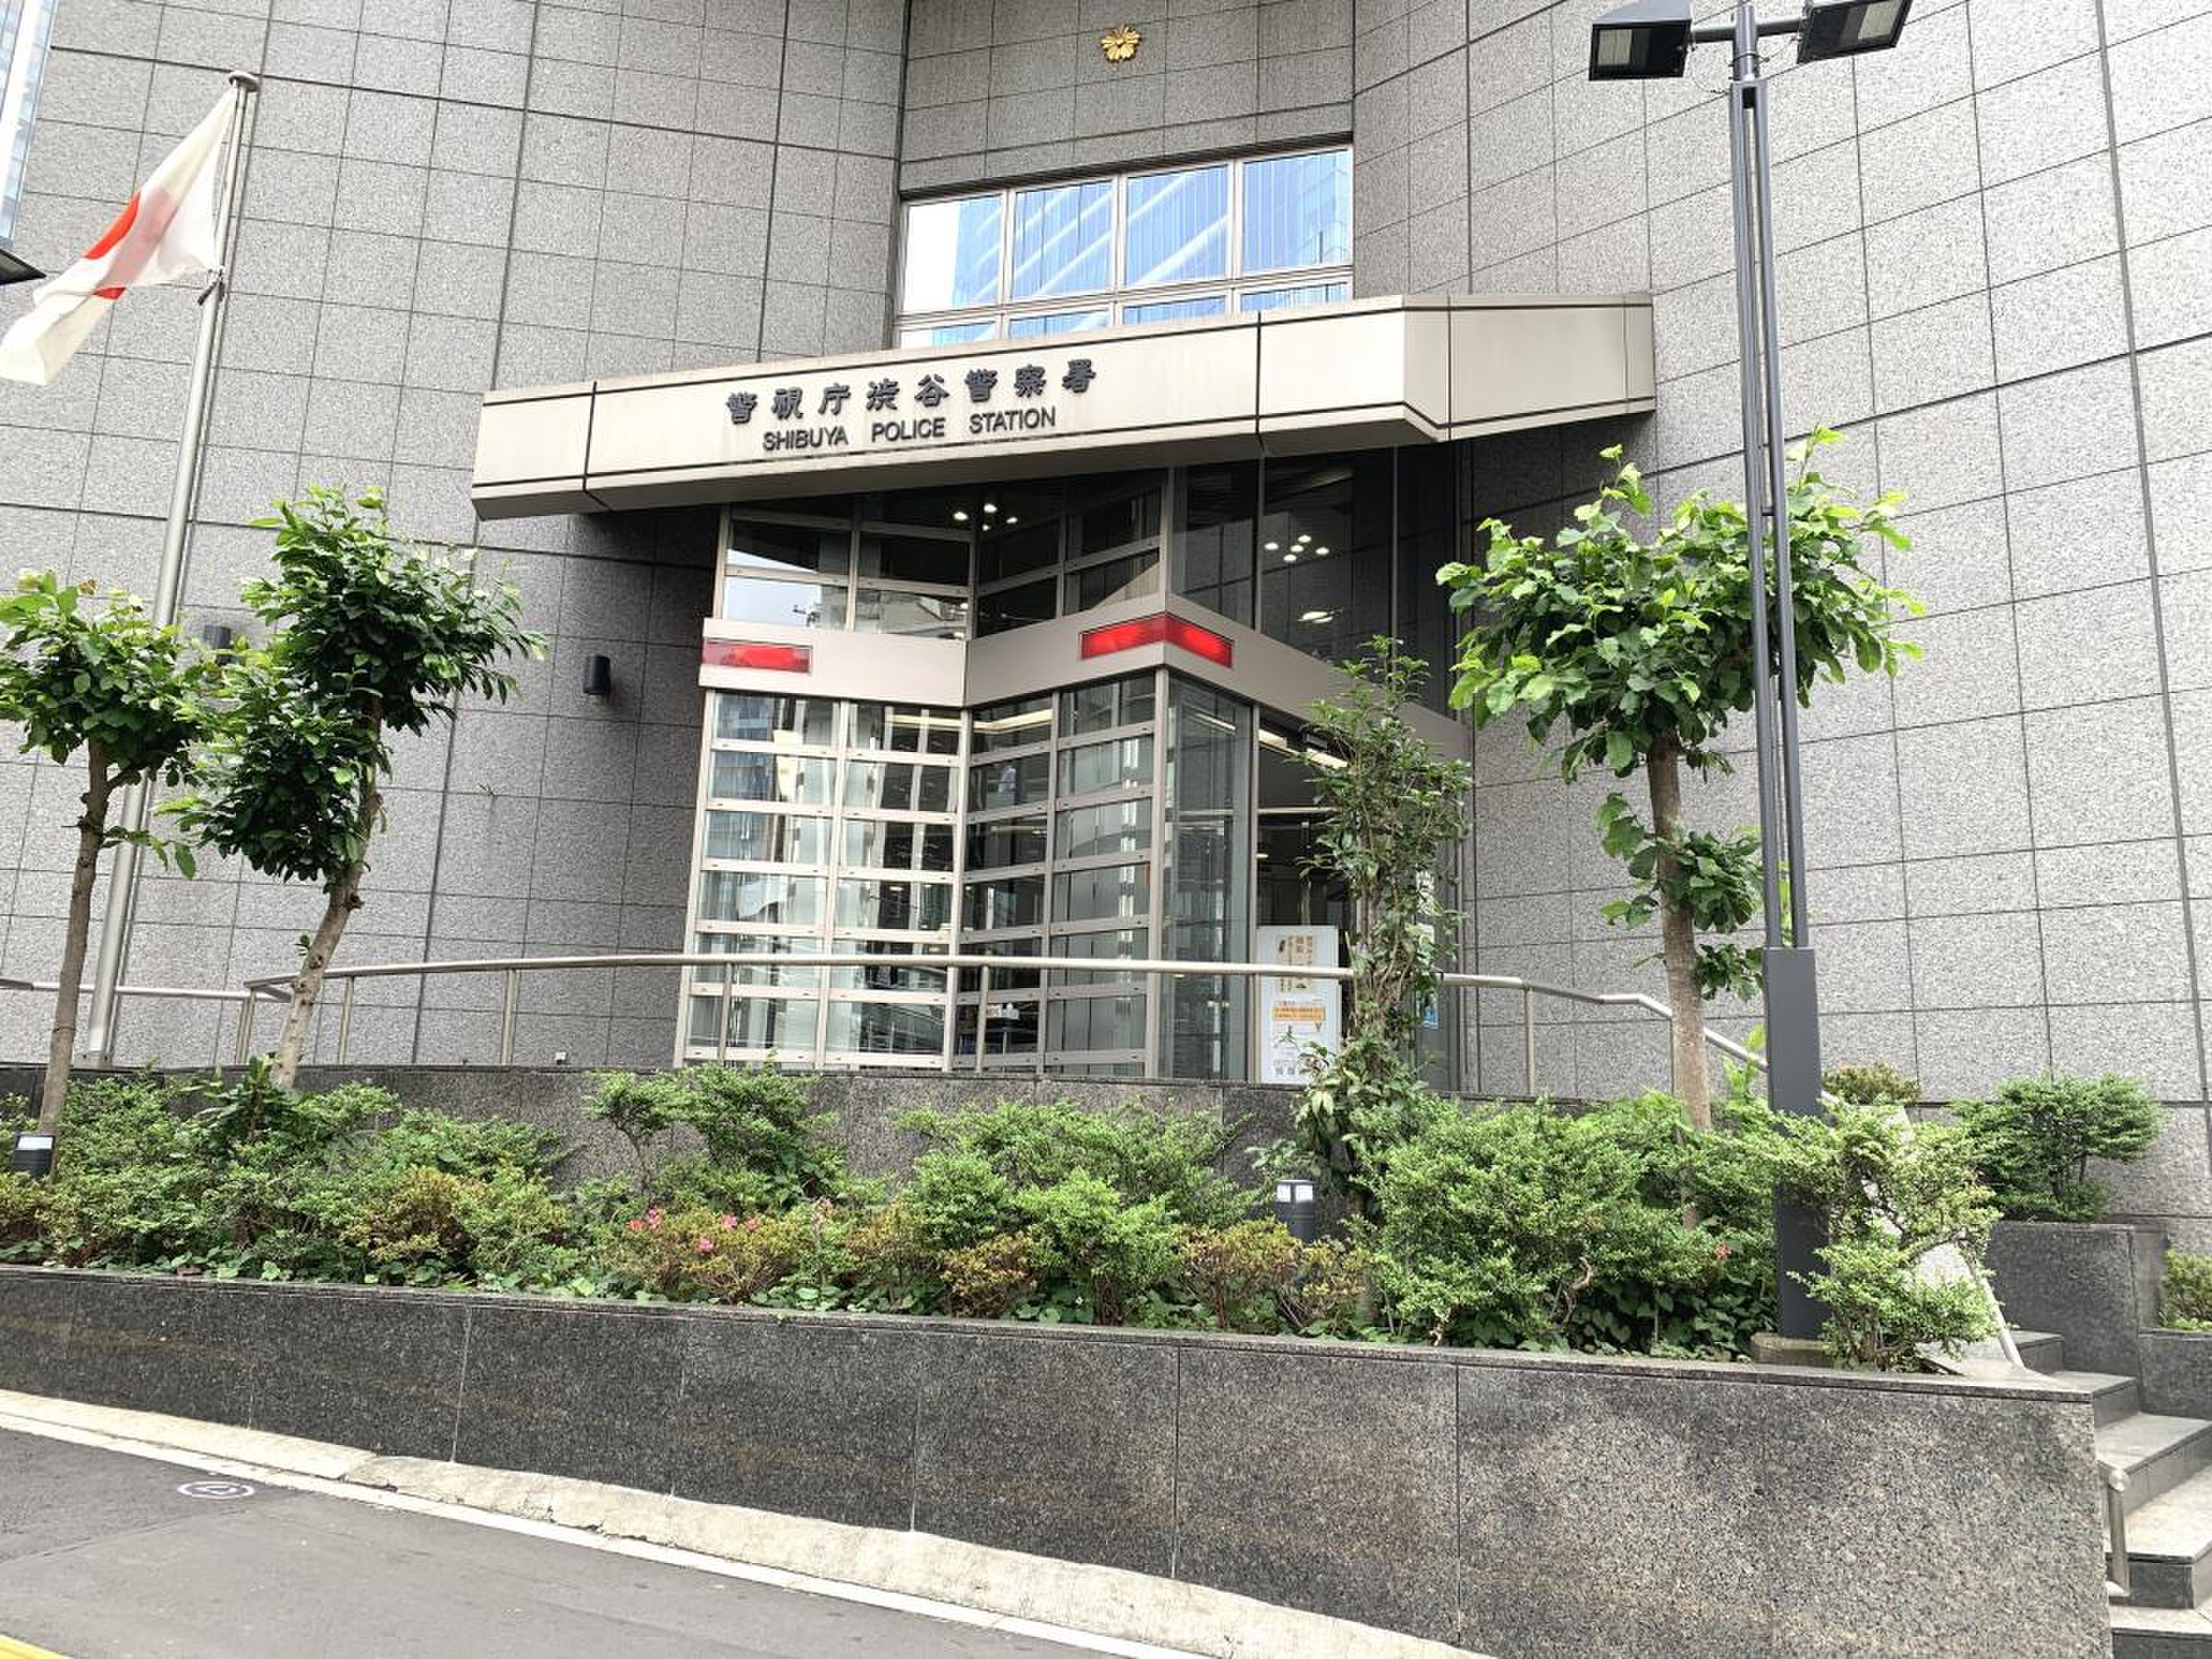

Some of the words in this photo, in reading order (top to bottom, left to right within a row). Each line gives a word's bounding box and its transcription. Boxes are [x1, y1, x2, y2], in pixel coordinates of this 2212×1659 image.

[725, 359, 1097, 424] 警視庁渋谷警察署
[763, 426, 849, 452] SHIBUYA
[871, 418, 946, 442] POLICE
[969, 406, 1056, 434] STATION
